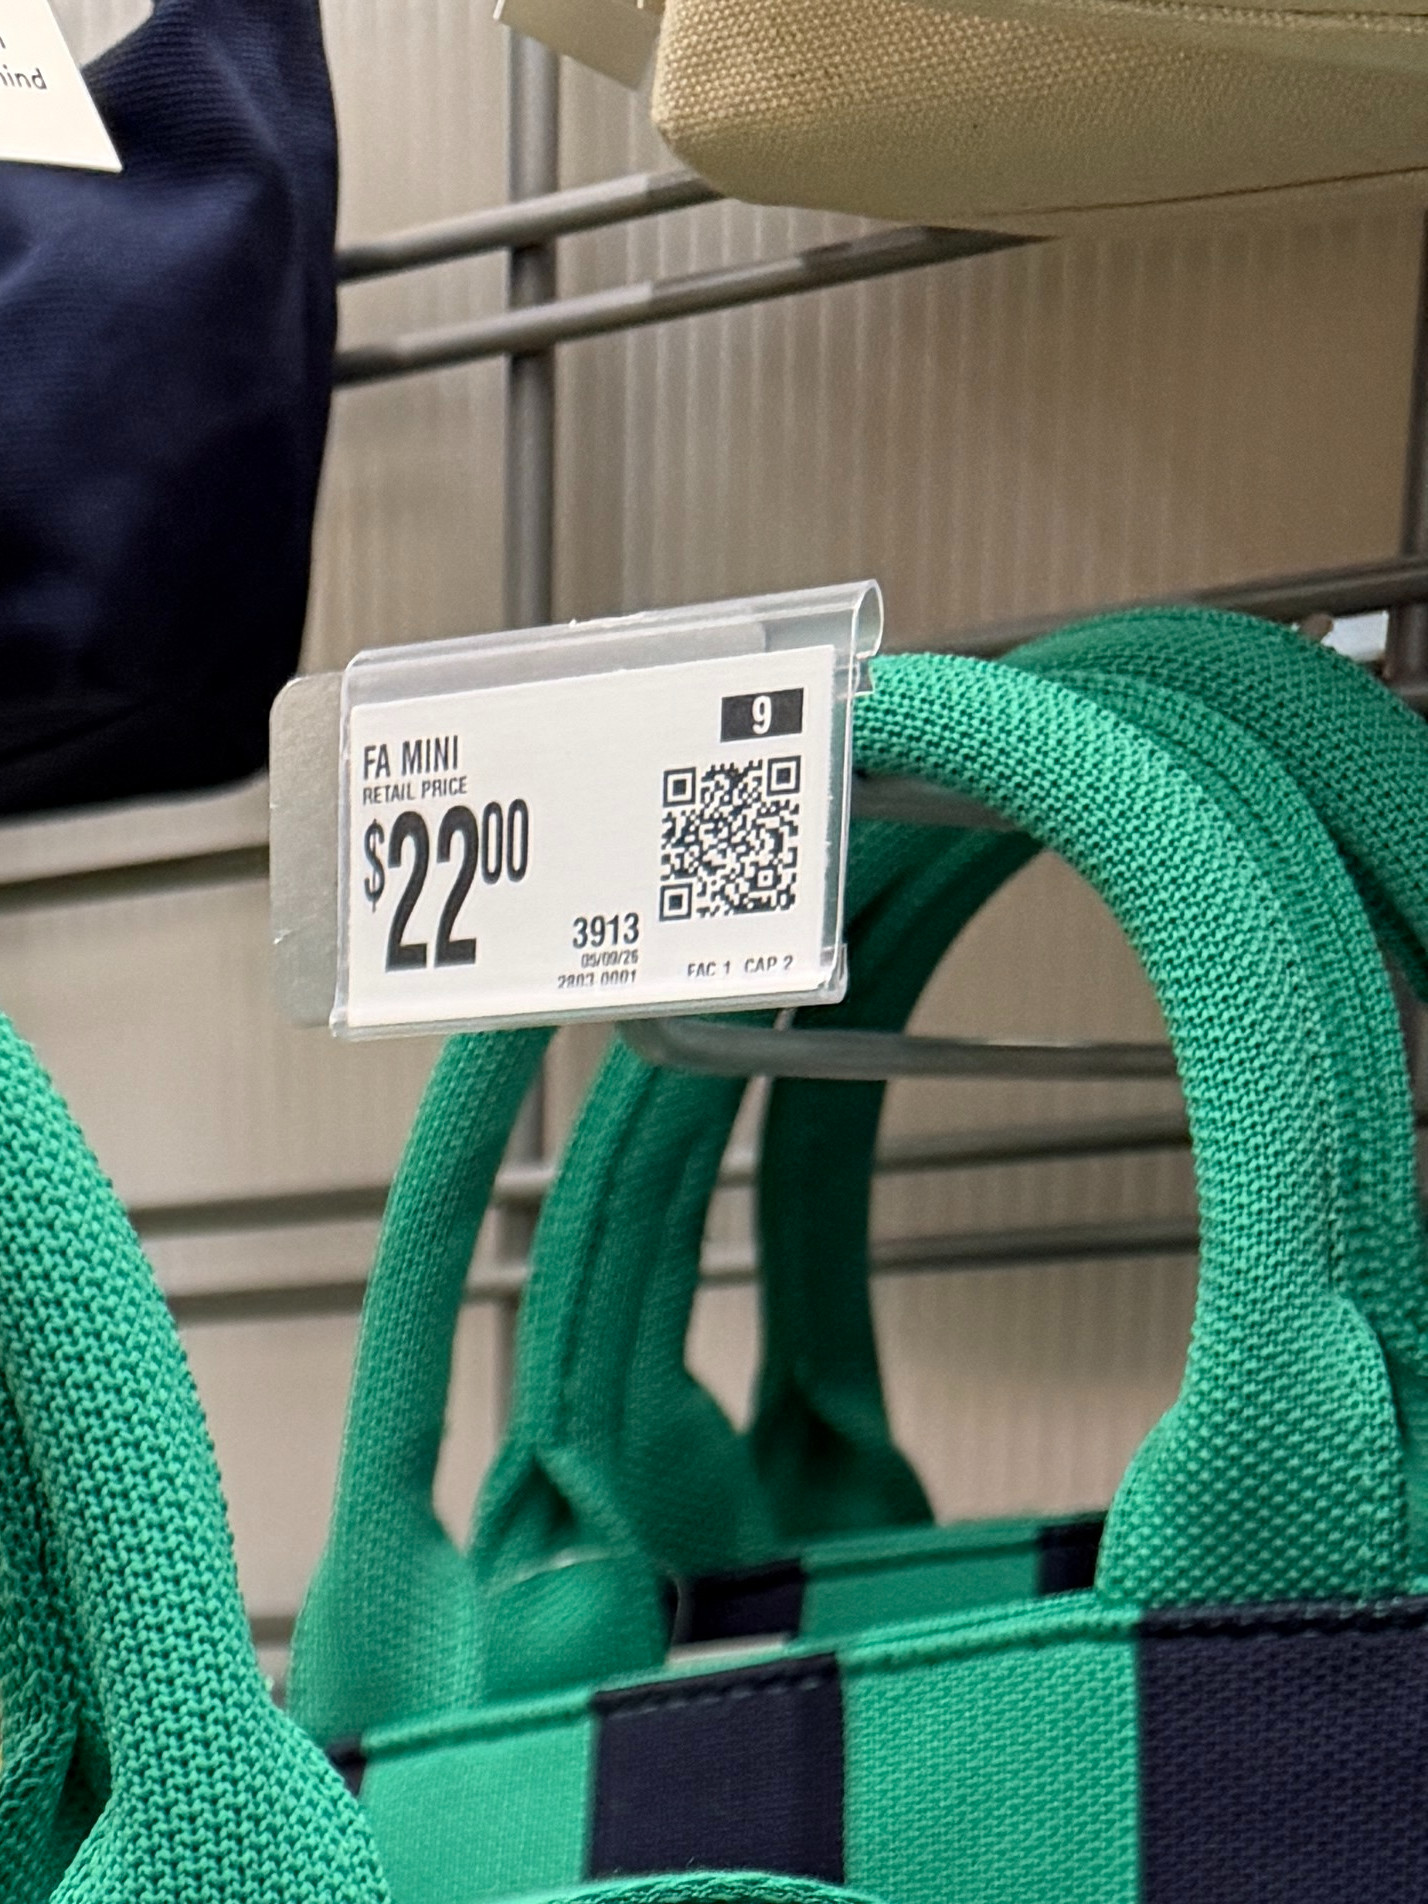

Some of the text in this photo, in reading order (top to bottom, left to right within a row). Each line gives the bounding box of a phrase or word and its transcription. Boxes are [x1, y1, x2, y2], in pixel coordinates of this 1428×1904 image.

[752, 695, 772, 735] 9
[363, 735, 459, 781] FA MINI
[362, 775, 469, 806] RETAIL PRICE
[572, 912, 640, 950] 3913
[687, 954, 795, 978] FAC 1 CAP 2
